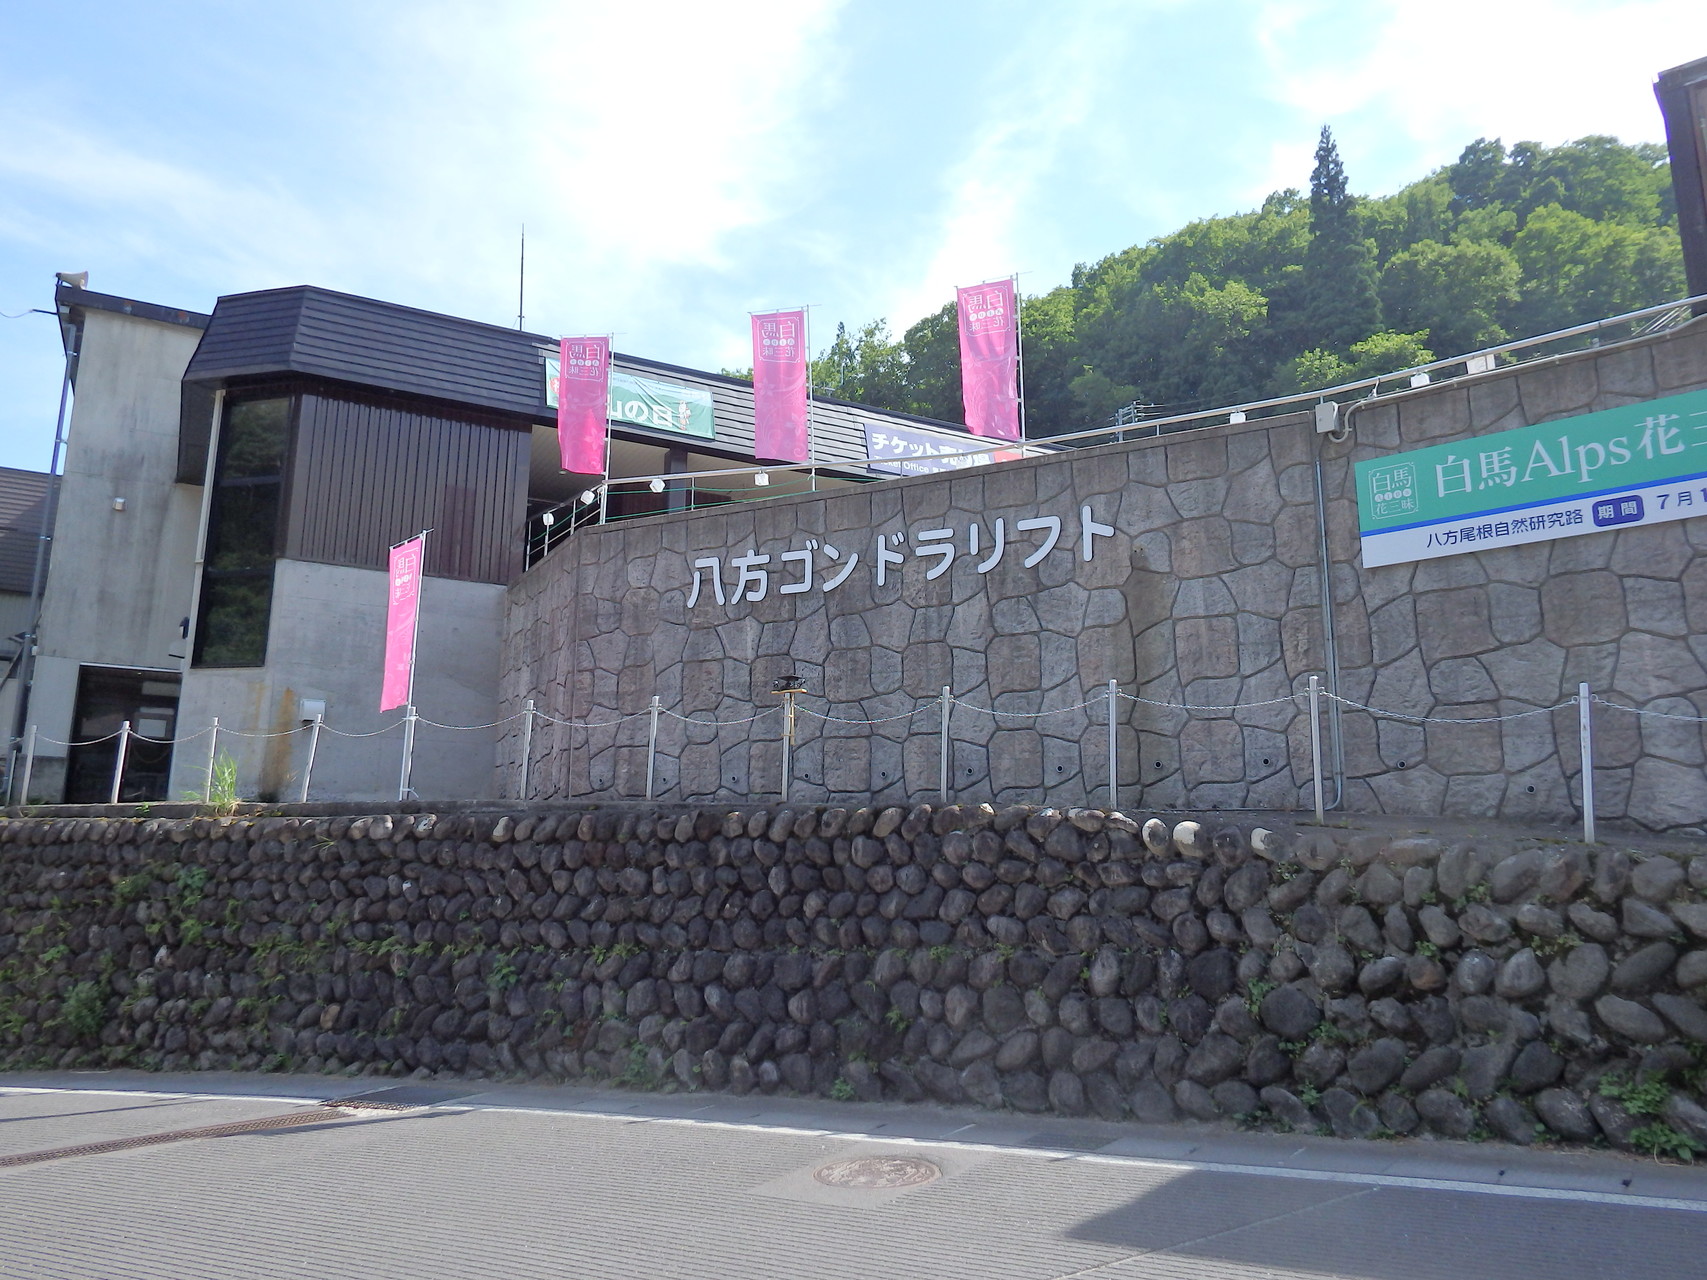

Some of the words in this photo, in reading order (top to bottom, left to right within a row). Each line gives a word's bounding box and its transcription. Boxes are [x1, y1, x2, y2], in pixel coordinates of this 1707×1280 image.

[903, 461, 930, 473] Office
[1372, 467, 1412, 493] 白馬
[1376, 498, 1415, 515] 花三昧
[1426, 509, 1584, 549] 八方尾根自然研究路
[1597, 500, 1638, 520] 期間
[687, 505, 1115, 609] 八方ゴンドラリフト
